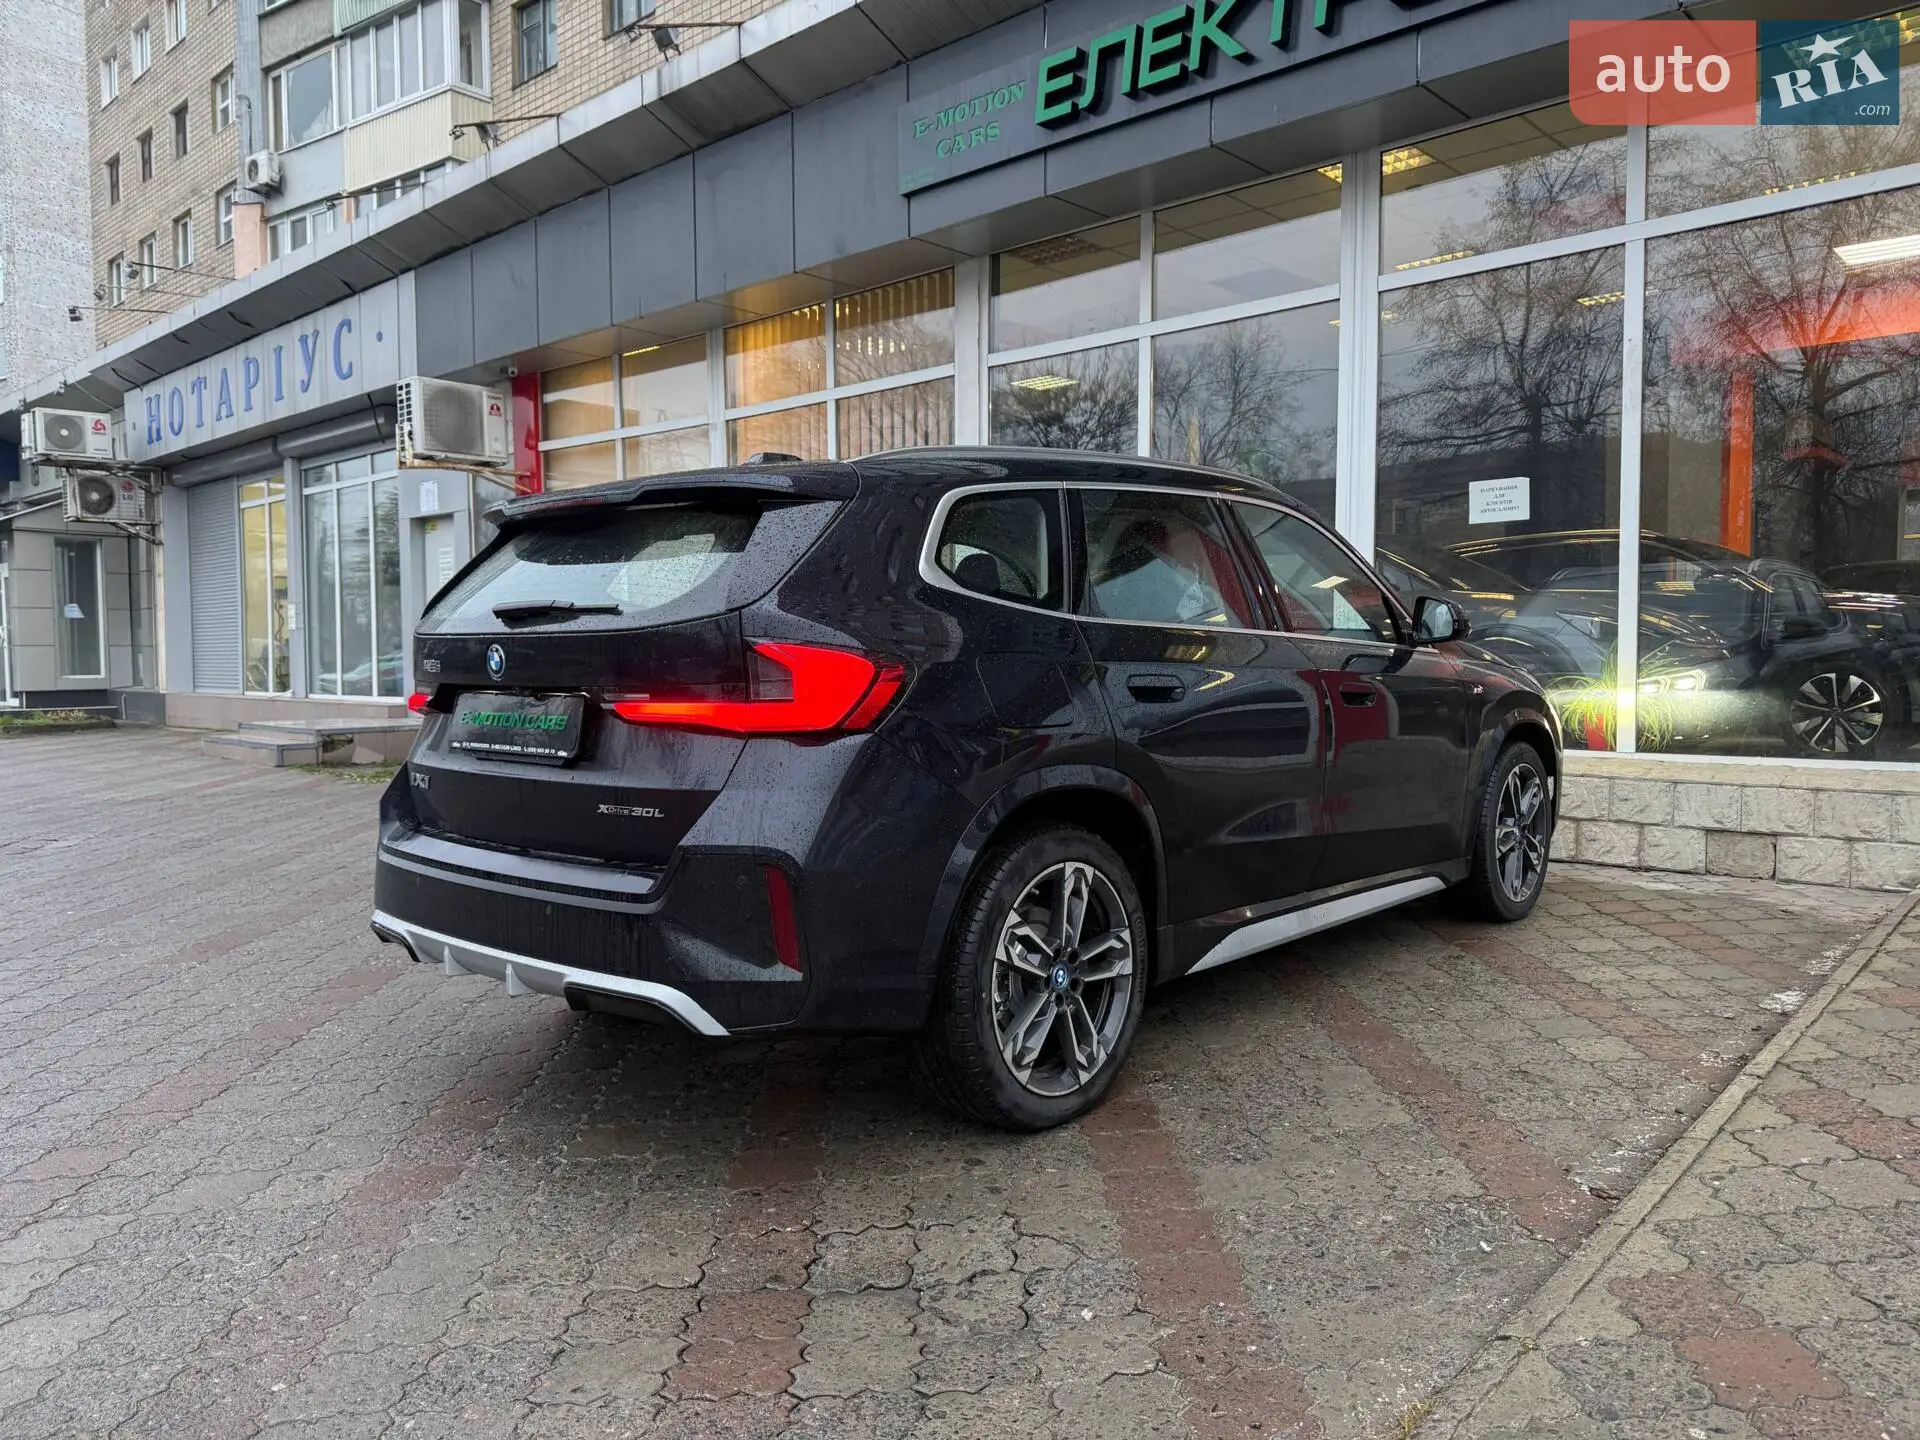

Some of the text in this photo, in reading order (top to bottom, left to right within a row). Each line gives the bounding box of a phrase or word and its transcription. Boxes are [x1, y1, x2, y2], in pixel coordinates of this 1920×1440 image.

[912, 80, 1026, 139] E-MOTION
[935, 120, 1001, 158] CARS
[145, 318, 353, 446] НОТАРІУС
[122, 493, 133, 501] LG
[525, 714, 569, 732] CARS
